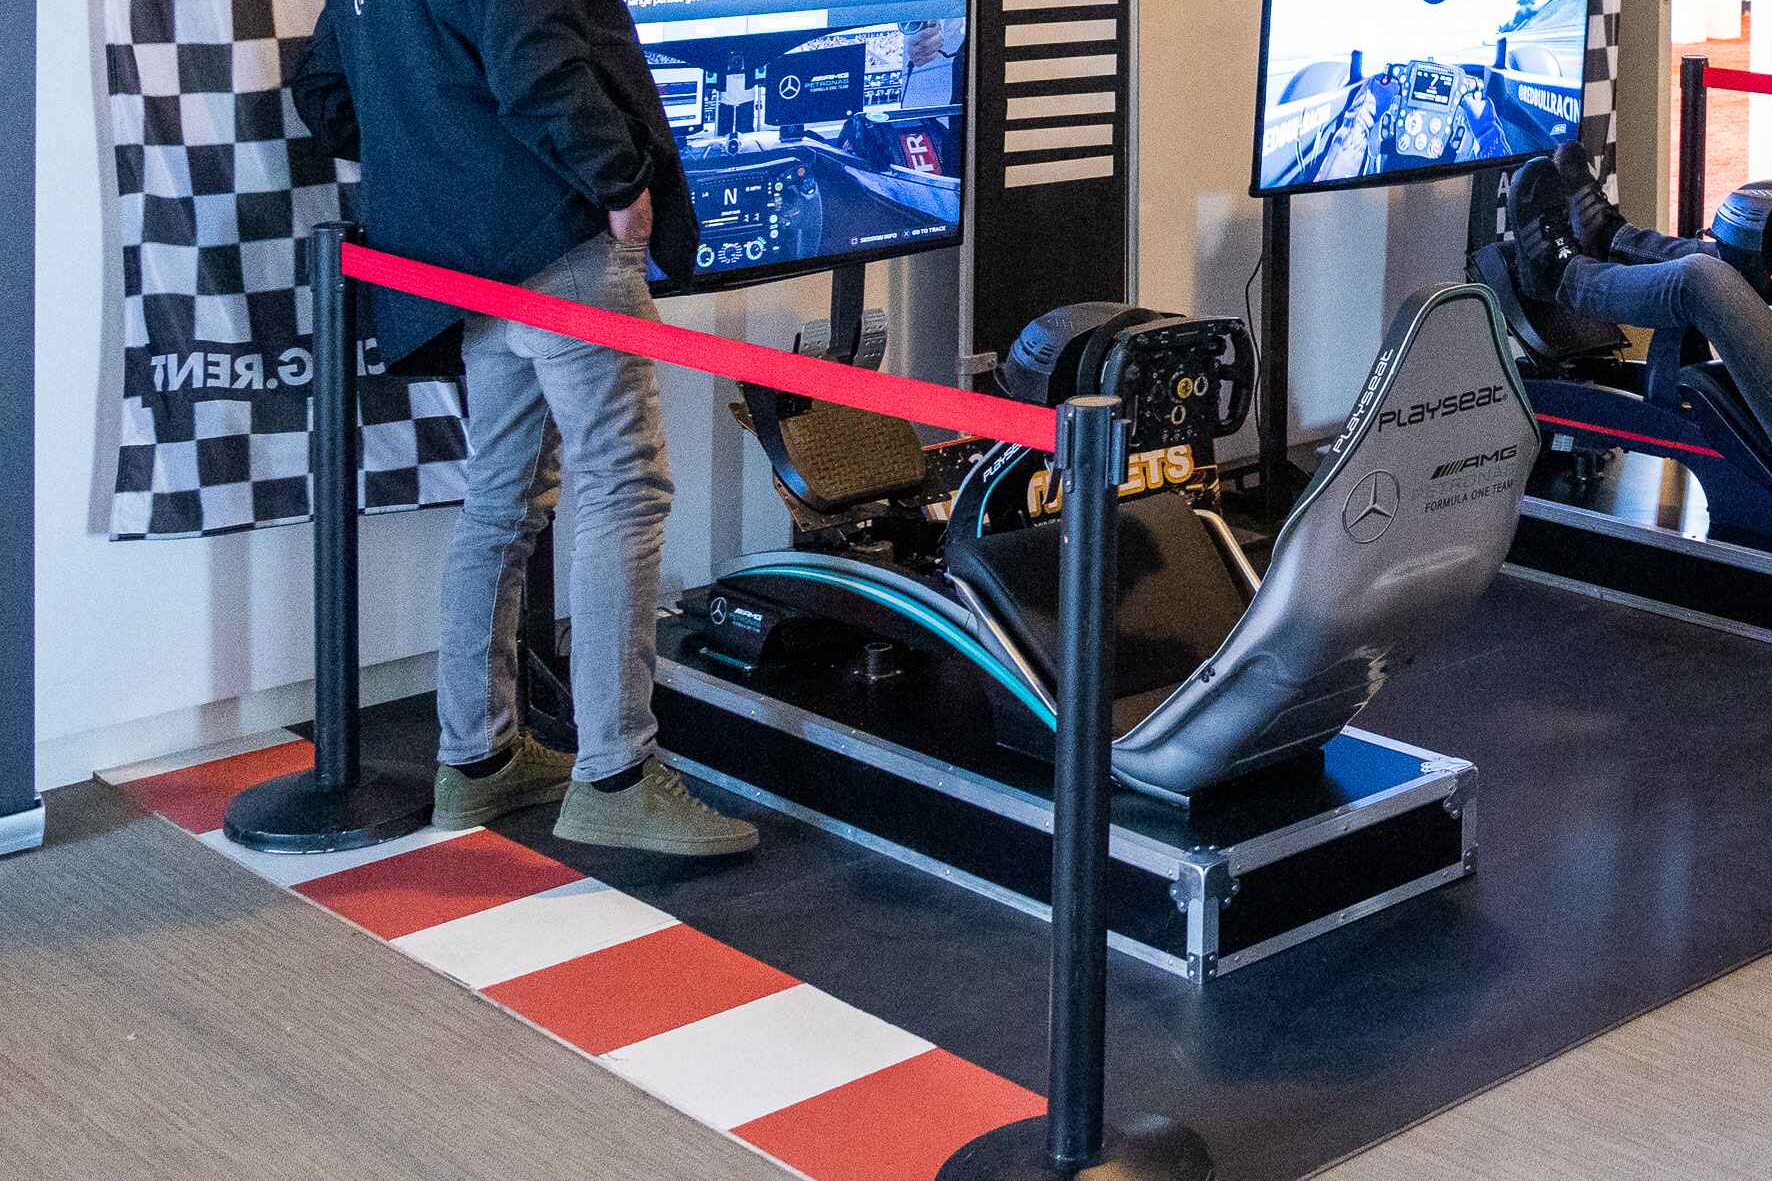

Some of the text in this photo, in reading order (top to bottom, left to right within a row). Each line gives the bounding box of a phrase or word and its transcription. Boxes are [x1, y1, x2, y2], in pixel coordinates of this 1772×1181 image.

[724, 187, 737, 206] N
[1423, 494, 1468, 514] FORMULA
[1471, 486, 1490, 500] ONE
[1492, 478, 1514, 494] TEAM
